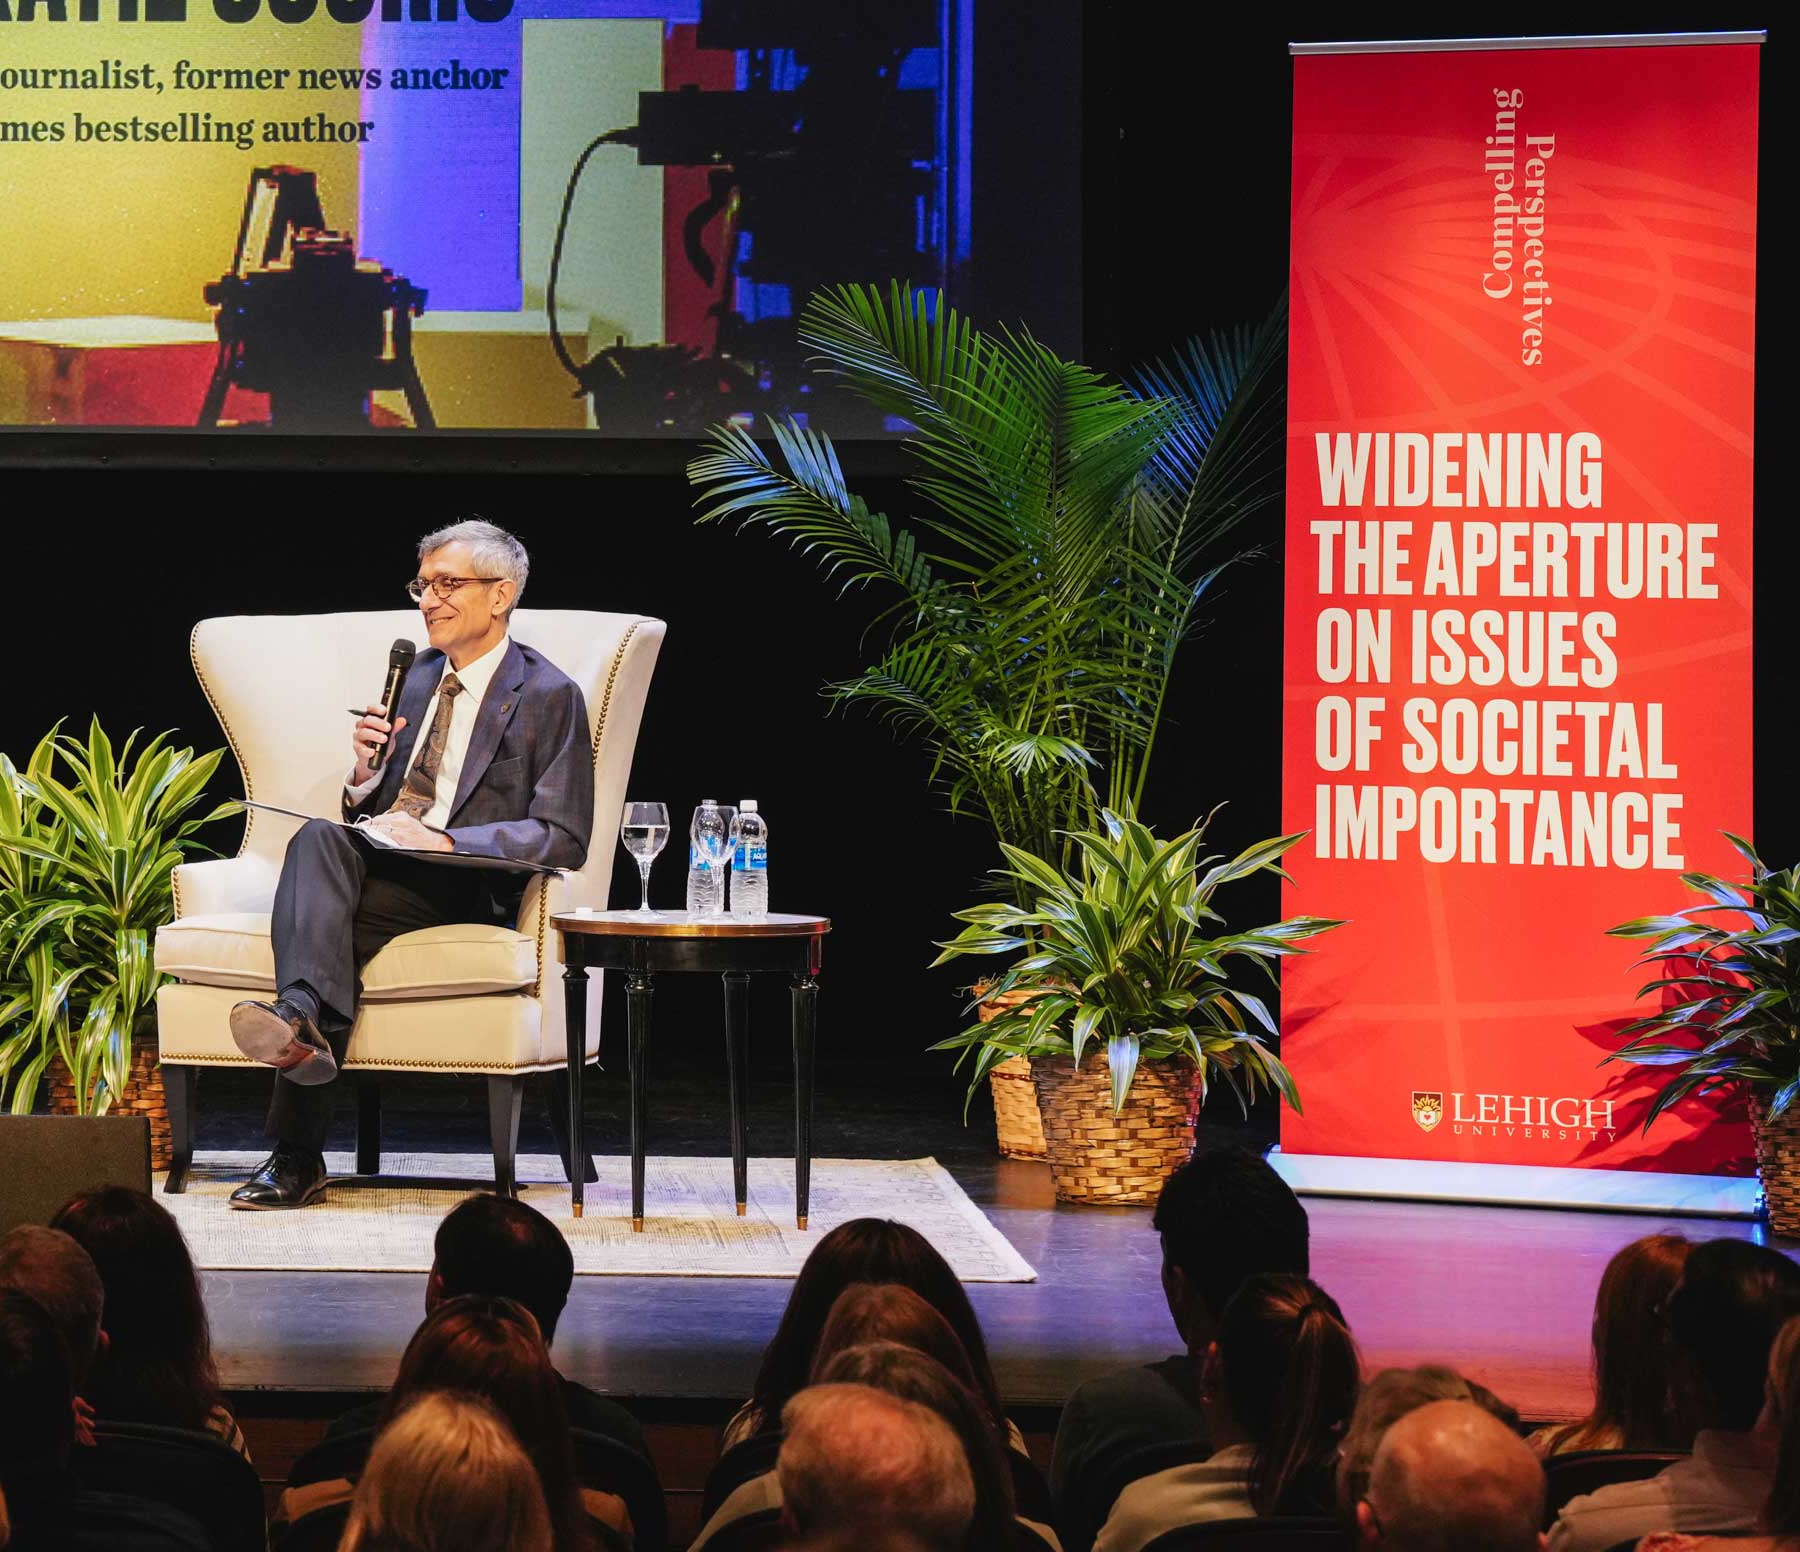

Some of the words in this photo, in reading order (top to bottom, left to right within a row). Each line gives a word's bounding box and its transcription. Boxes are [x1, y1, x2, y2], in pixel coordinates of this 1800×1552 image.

[173, 60, 290, 90] former
[298, 67, 382, 91] news
[390, 60, 509, 91] anchor
[74, 113, 255, 151] bestselling
[262, 113, 375, 143] author
[1483, 88, 1523, 299] Compelling
[1517, 133, 1555, 367] Perspectives
[1315, 432, 1602, 509] WIDENING
[1310, 521, 1412, 595] THE
[1423, 522, 1719, 600] APERTURE
[1316, 608, 1391, 685] ON
[1411, 610, 1618, 688] ISSUES
[1316, 696, 1386, 772] OF
[1402, 697, 1678, 779] SOCIETAL
[1315, 784, 1685, 870] IMPORTANCE
[1452, 1092, 1616, 1130] LEHIGH
[1454, 1124, 1616, 1143] UNIVERSITY
